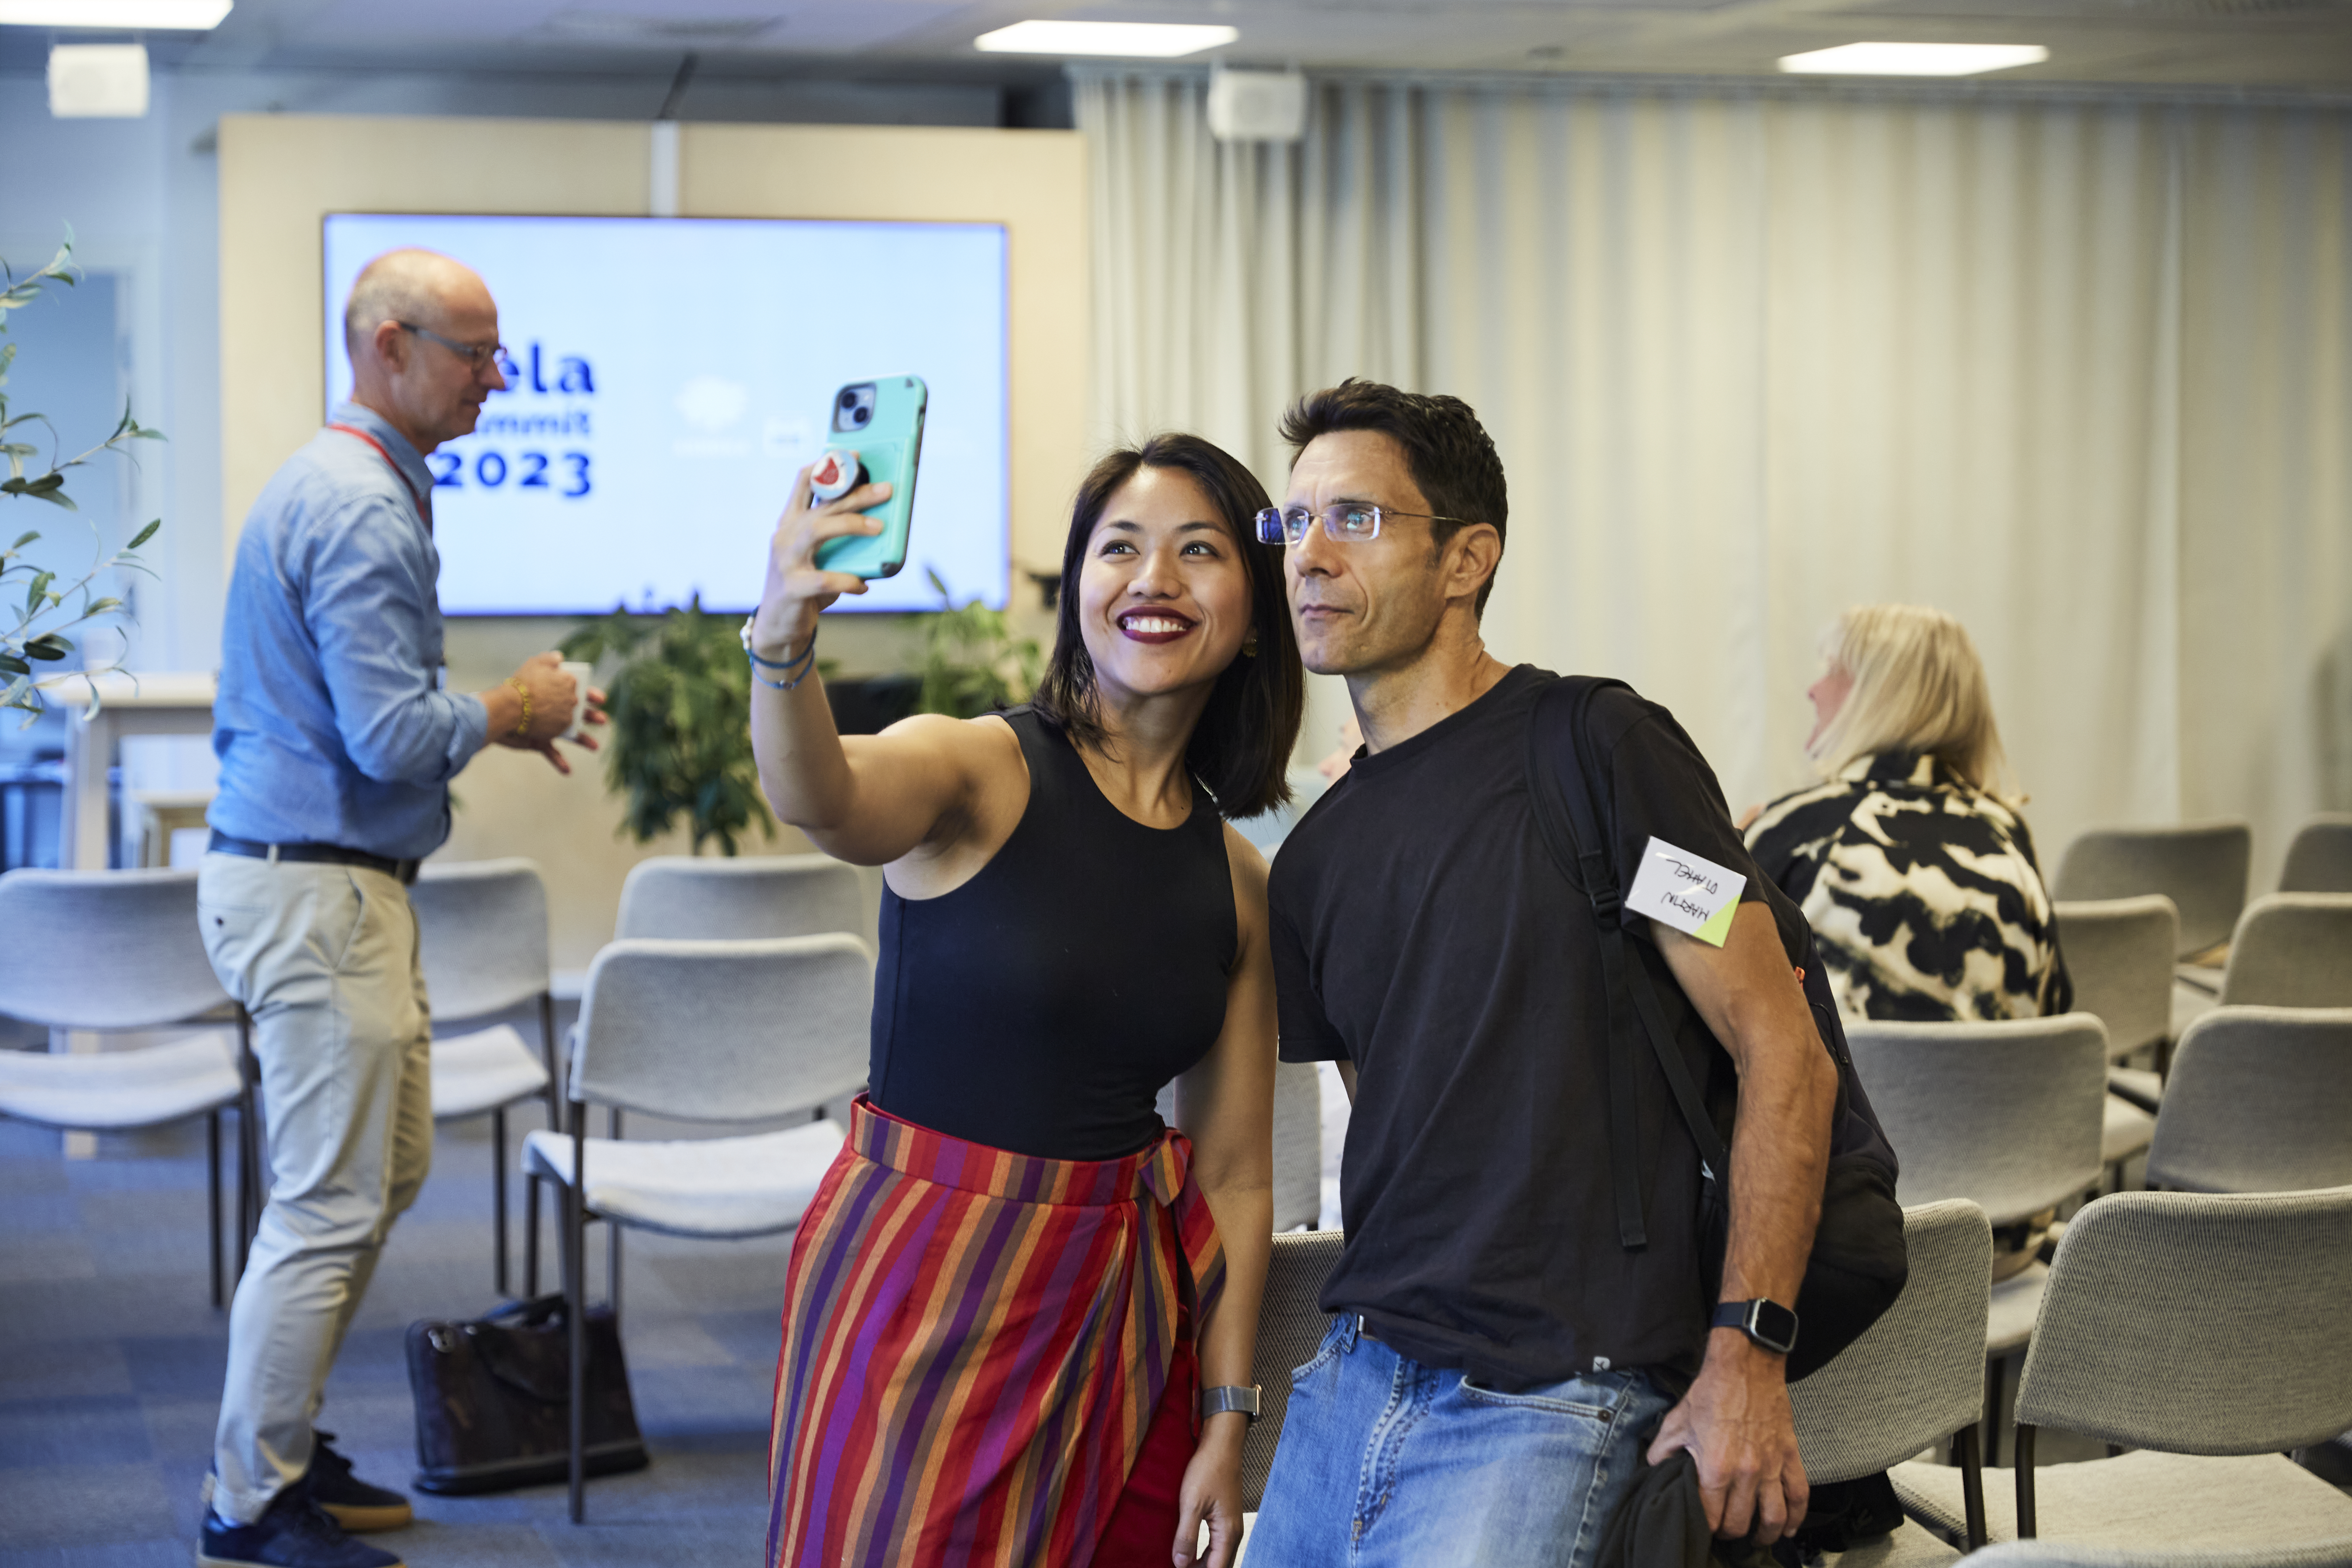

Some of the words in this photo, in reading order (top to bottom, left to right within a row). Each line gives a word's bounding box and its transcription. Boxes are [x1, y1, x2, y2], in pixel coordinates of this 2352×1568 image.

[502, 343, 594, 392] ela
[479, 408, 590, 434] mmit
[434, 453, 590, 497] 2023
[1660, 892, 1710, 922] MARTIN
